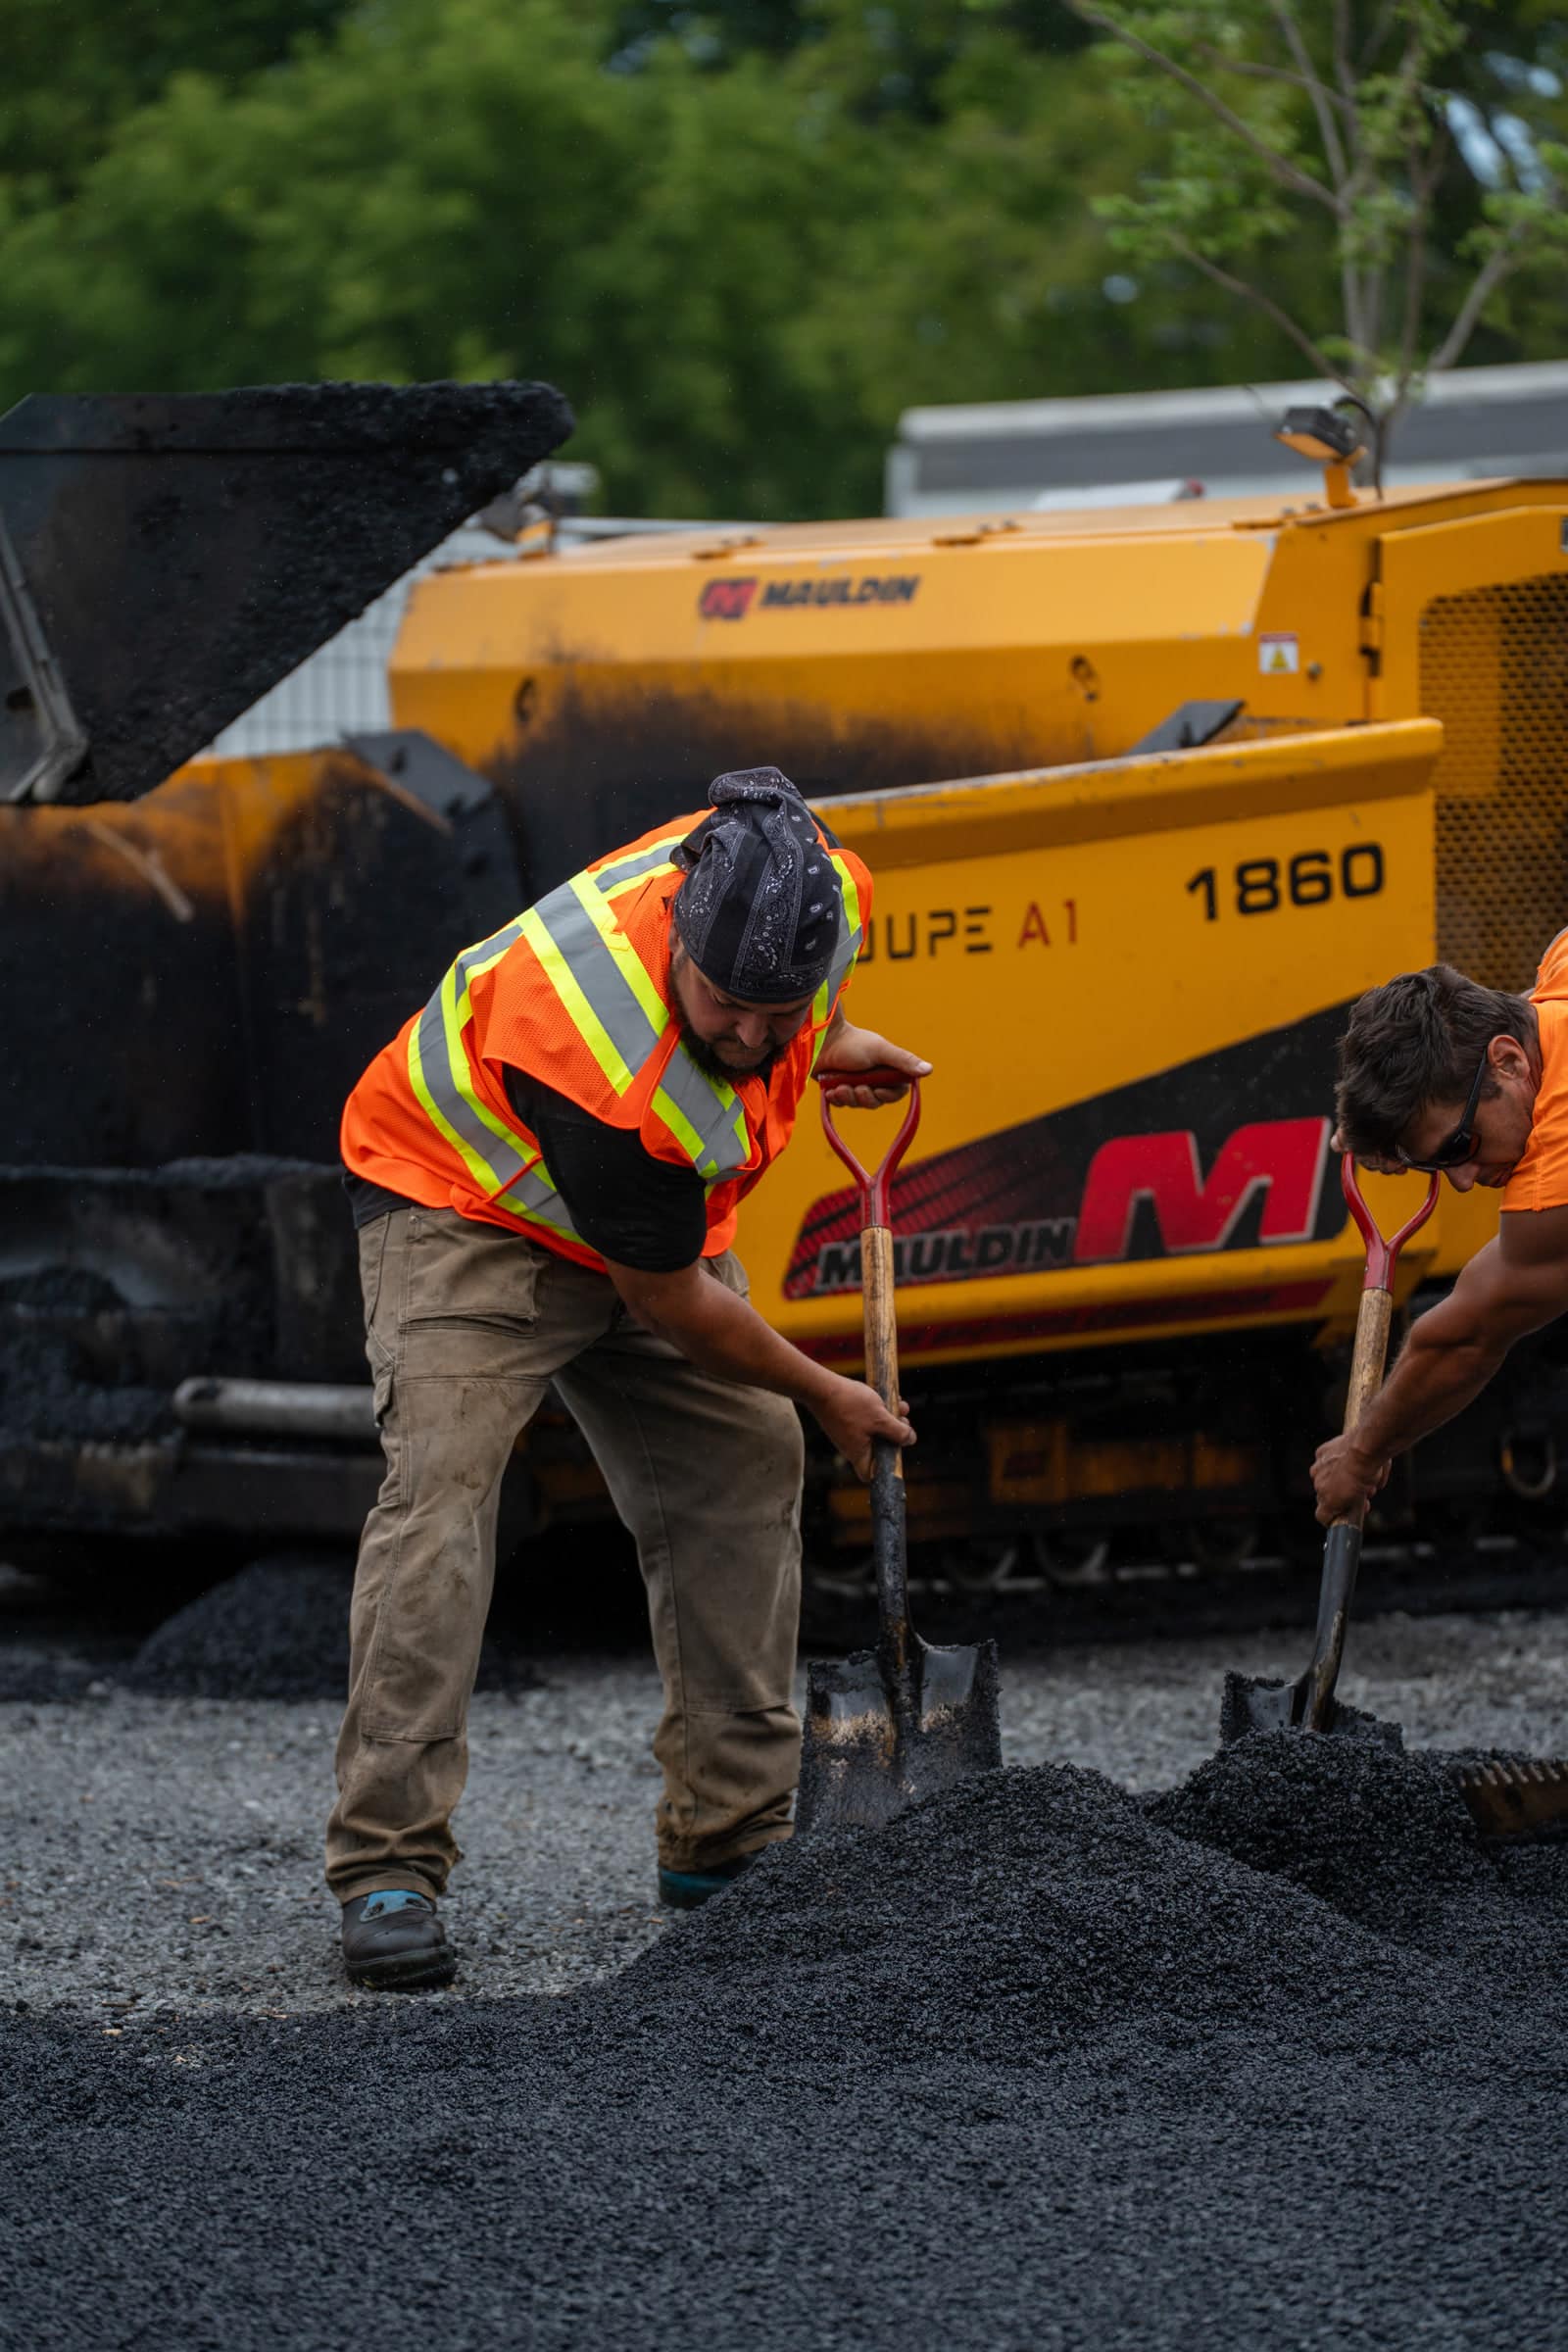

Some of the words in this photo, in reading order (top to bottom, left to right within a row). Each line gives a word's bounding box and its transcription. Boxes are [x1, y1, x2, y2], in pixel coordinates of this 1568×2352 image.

[761, 575, 919, 607] MAULDIN
[1186, 842, 1386, 922] 1860
[1016, 899, 1077, 951] A1
